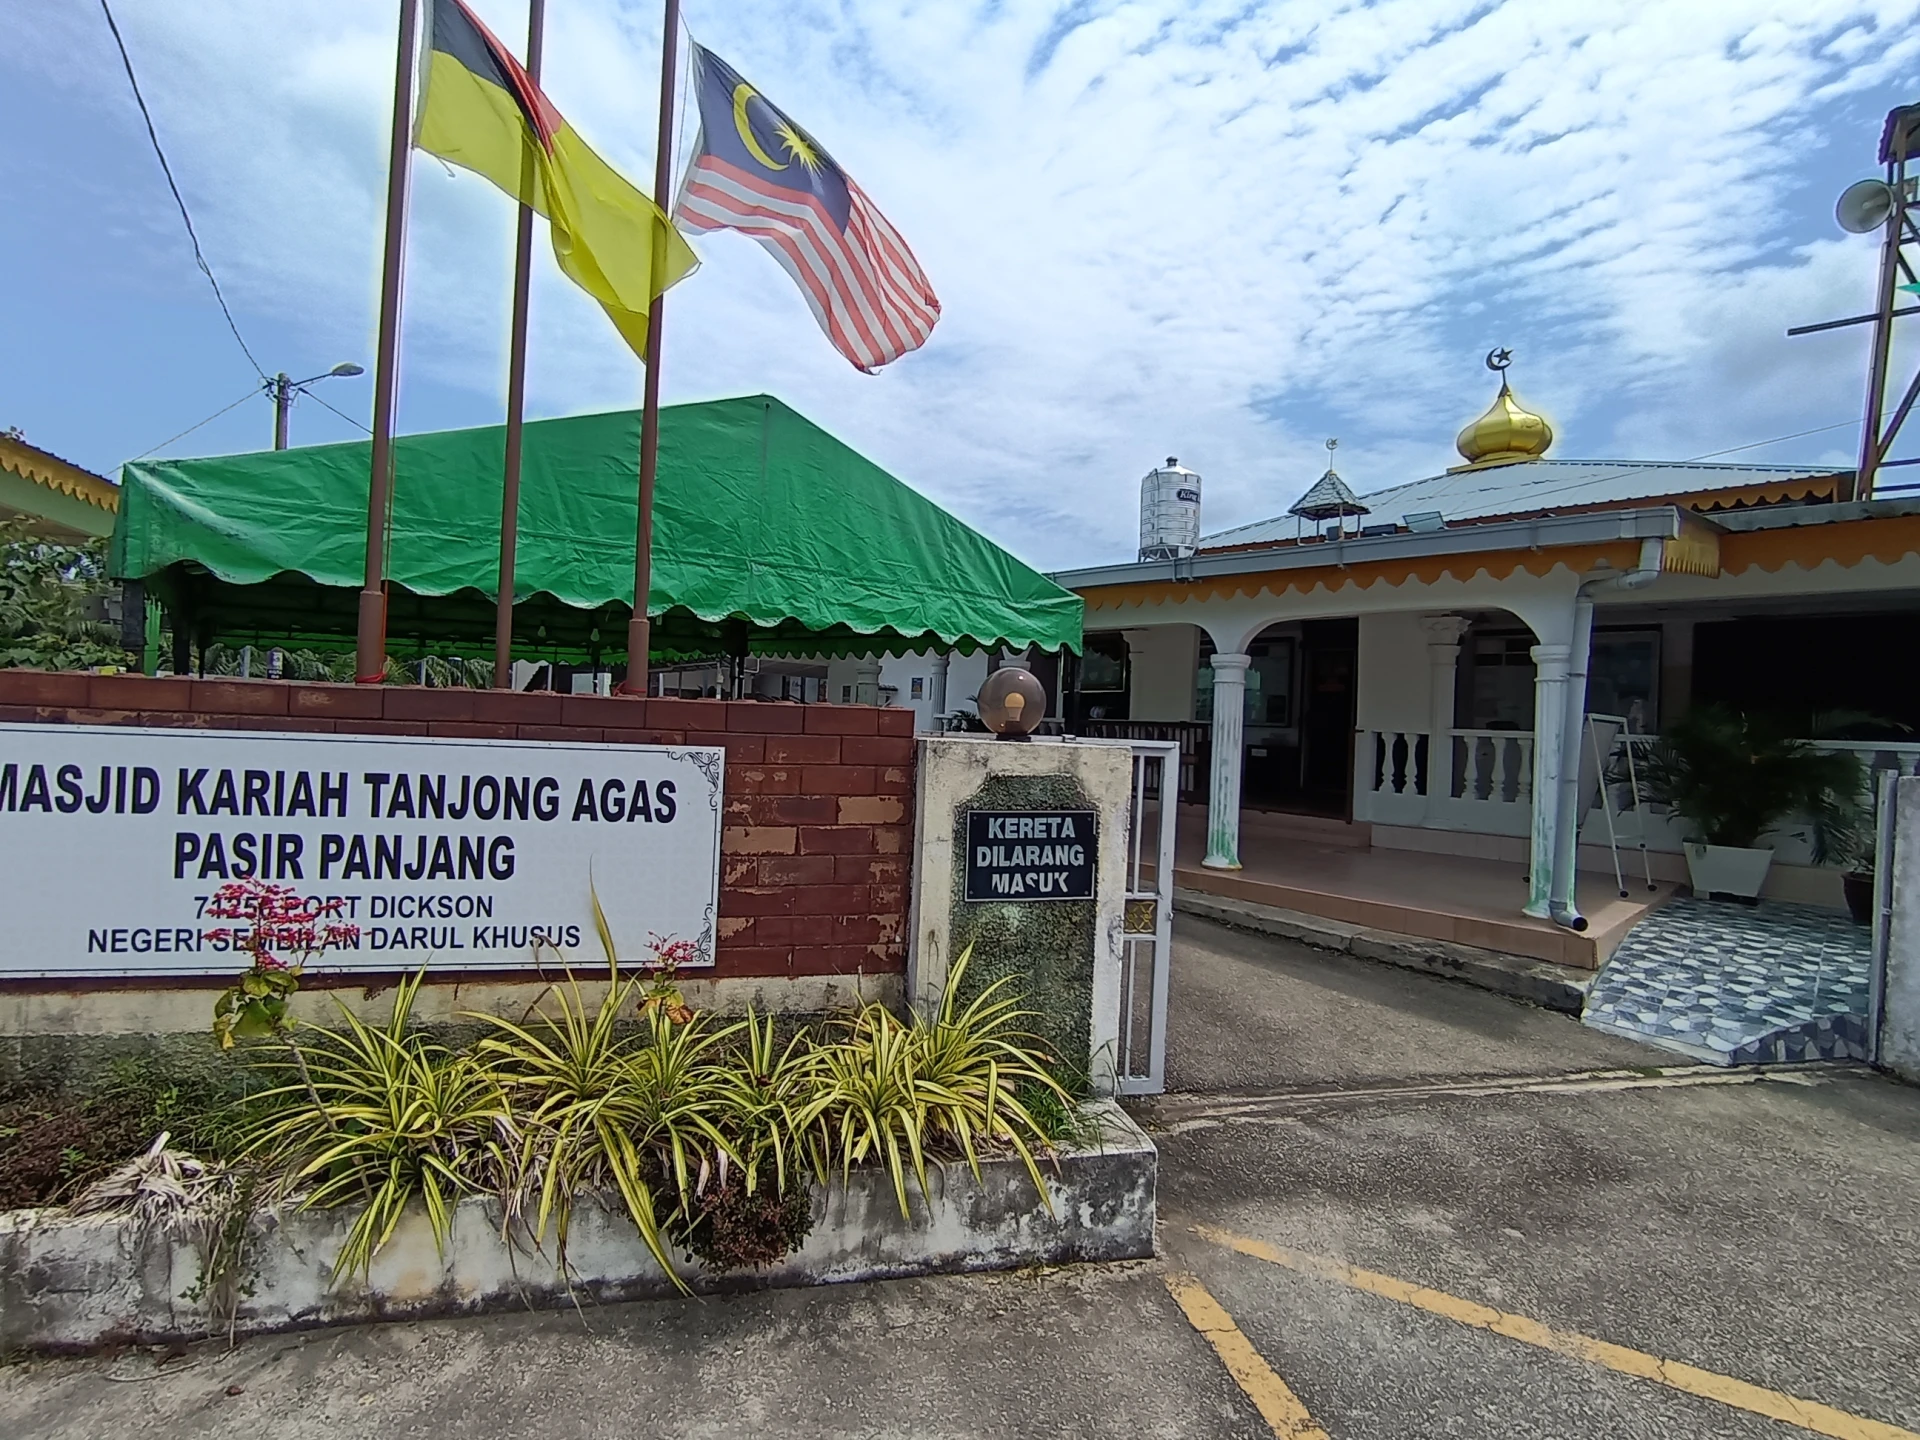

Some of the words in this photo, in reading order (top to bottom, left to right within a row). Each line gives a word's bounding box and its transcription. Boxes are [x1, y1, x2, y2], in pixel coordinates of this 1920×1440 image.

[177, 768, 348, 818] KARIAH
[363, 772, 560, 822] TANJONG
[571, 778, 677, 824] AGAS
[988, 817, 1076, 839] KERETA
[174, 832, 304, 880] PASIR
[319, 834, 515, 881] PANJANG
[976, 844, 1085, 867] DILARANG
[991, 871, 1069, 895] MASUK
[285, 895, 362, 919] PORT
[370, 895, 493, 919] DICKSON
[88, 928, 206, 954] NEGERI
[366, 926, 465, 951] DARUL
[473, 924, 581, 951] KHUSUS
